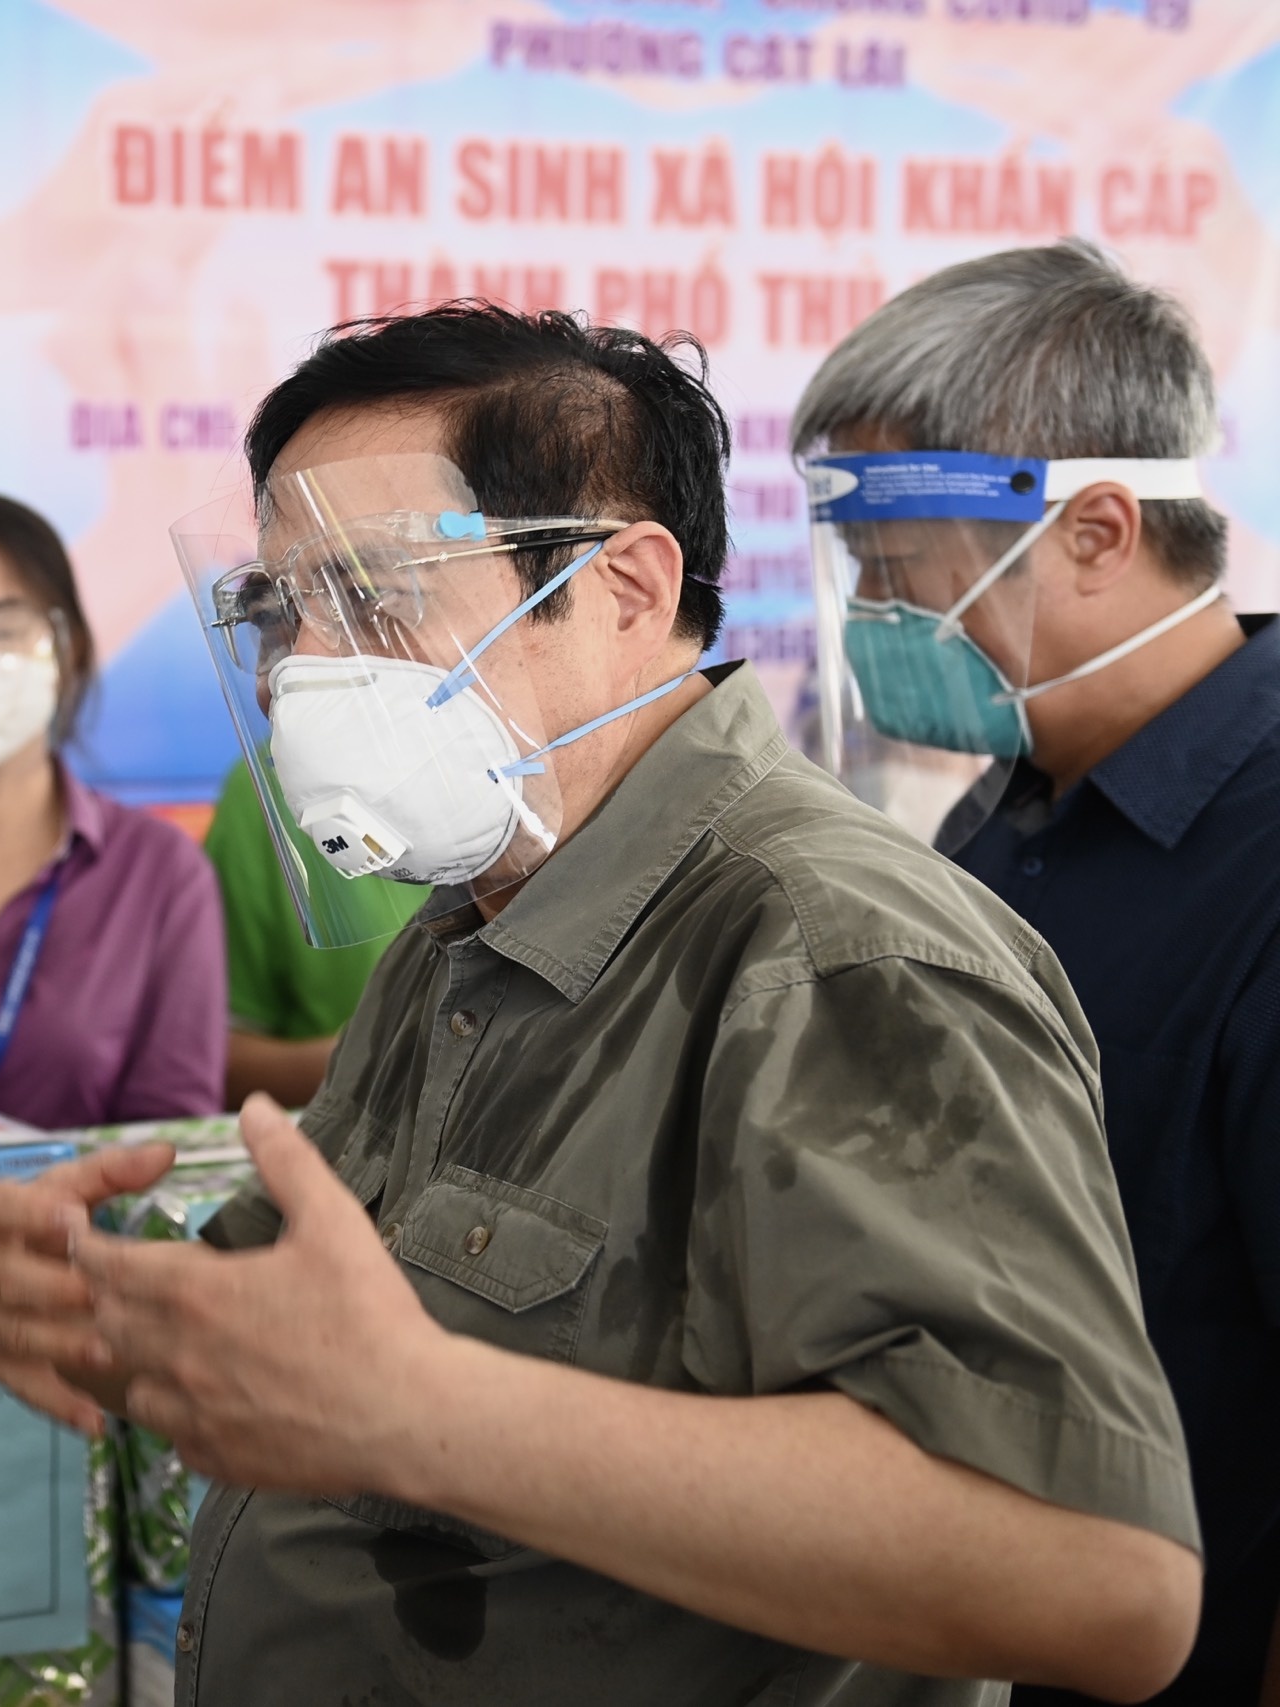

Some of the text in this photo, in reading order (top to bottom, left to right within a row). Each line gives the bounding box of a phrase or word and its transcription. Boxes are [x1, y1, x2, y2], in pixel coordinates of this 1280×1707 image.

[330, 133, 425, 215] AN
[457, 138, 625, 225] SINH
[321, 835, 349, 854] 3M
